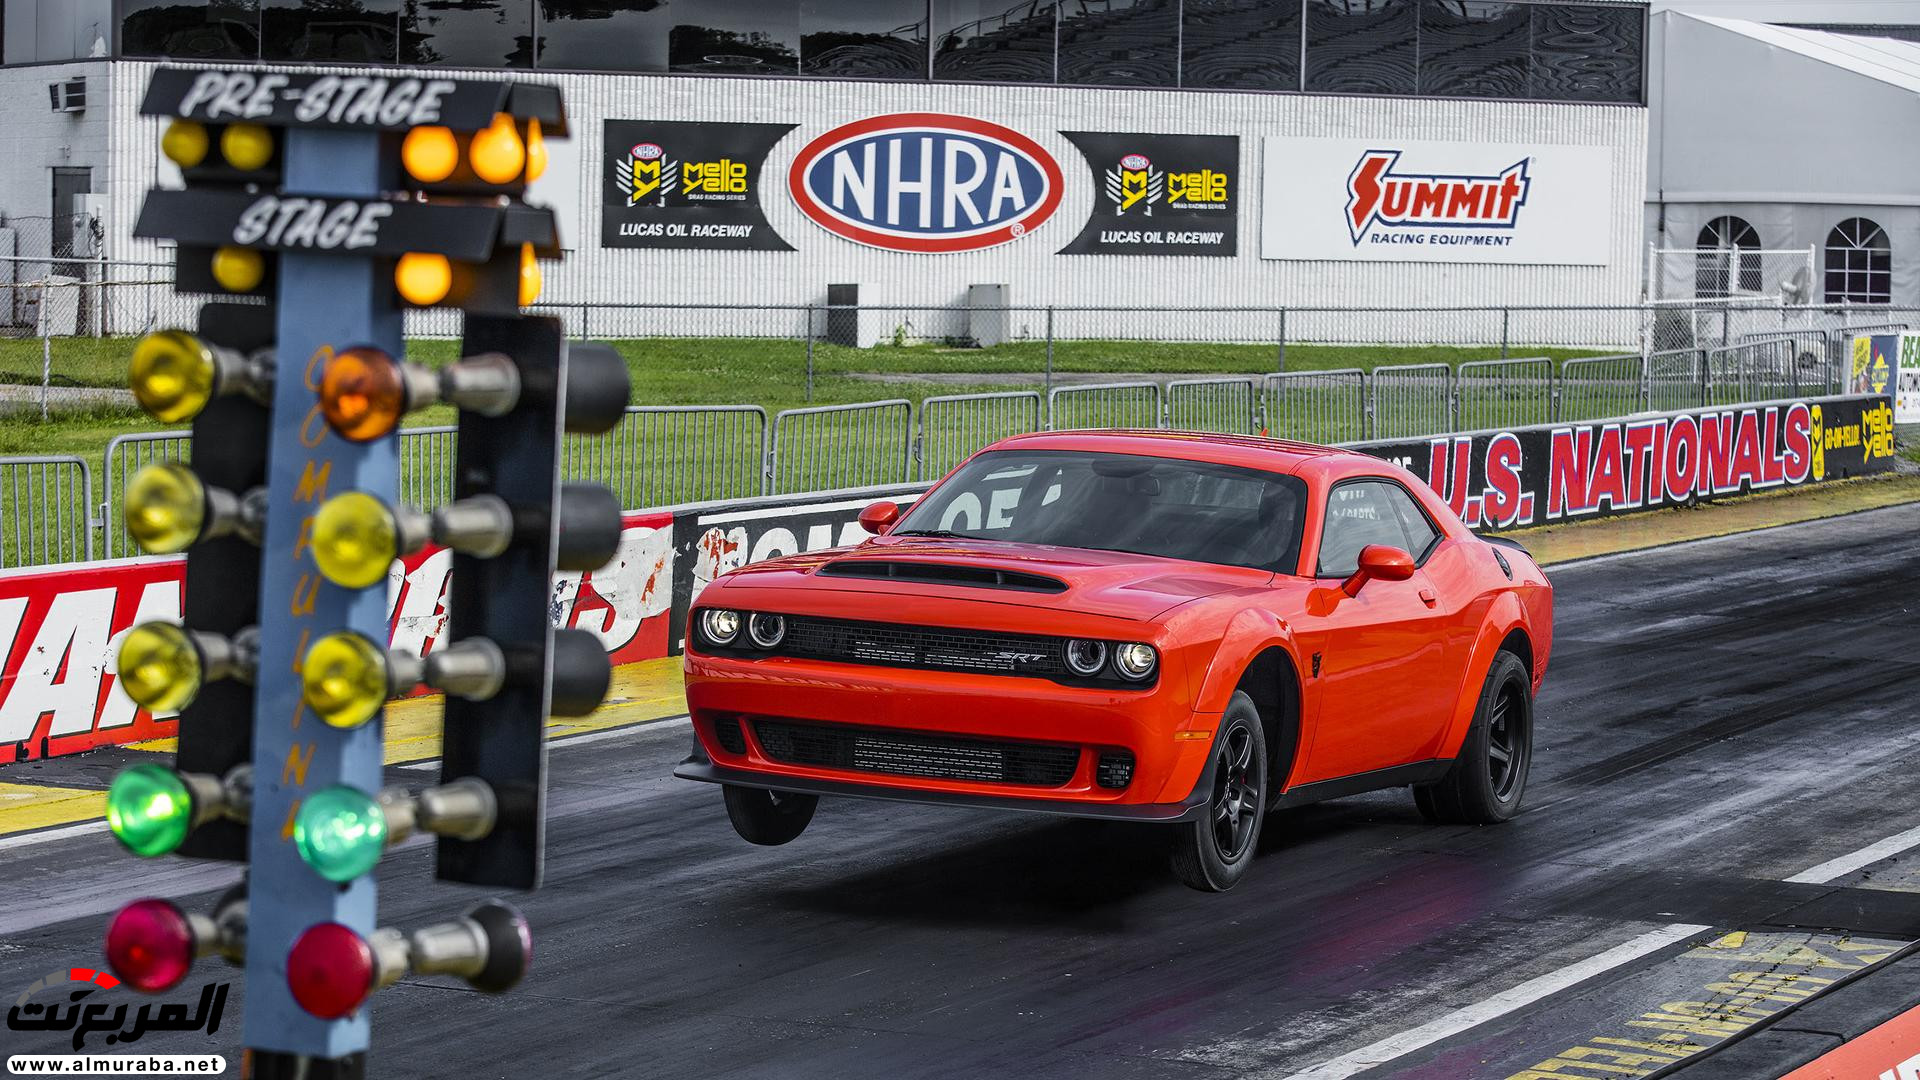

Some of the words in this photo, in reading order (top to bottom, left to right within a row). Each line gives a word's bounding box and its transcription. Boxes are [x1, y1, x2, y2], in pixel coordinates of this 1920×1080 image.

[178, 71, 457, 126] PRE-STAGE
[831, 137, 1026, 228] NHRA
[232, 195, 394, 250] STAGE
[619, 223, 663, 236] LUCAS
[666, 224, 689, 237] OIL
[690, 225, 753, 238] RACEWAY
[1100, 231, 1141, 243] LUCAS
[1143, 231, 1164, 244] OIL
[1166, 232, 1224, 244] RACEWAY
[1371, 233, 1424, 245] RACING
[1429, 234, 1513, 246] EQUIPMENT
[1428, 432, 1535, 528] U.S.
[1546, 402, 1811, 520] NATIONALS
[995, 651, 1047, 663] SRT
